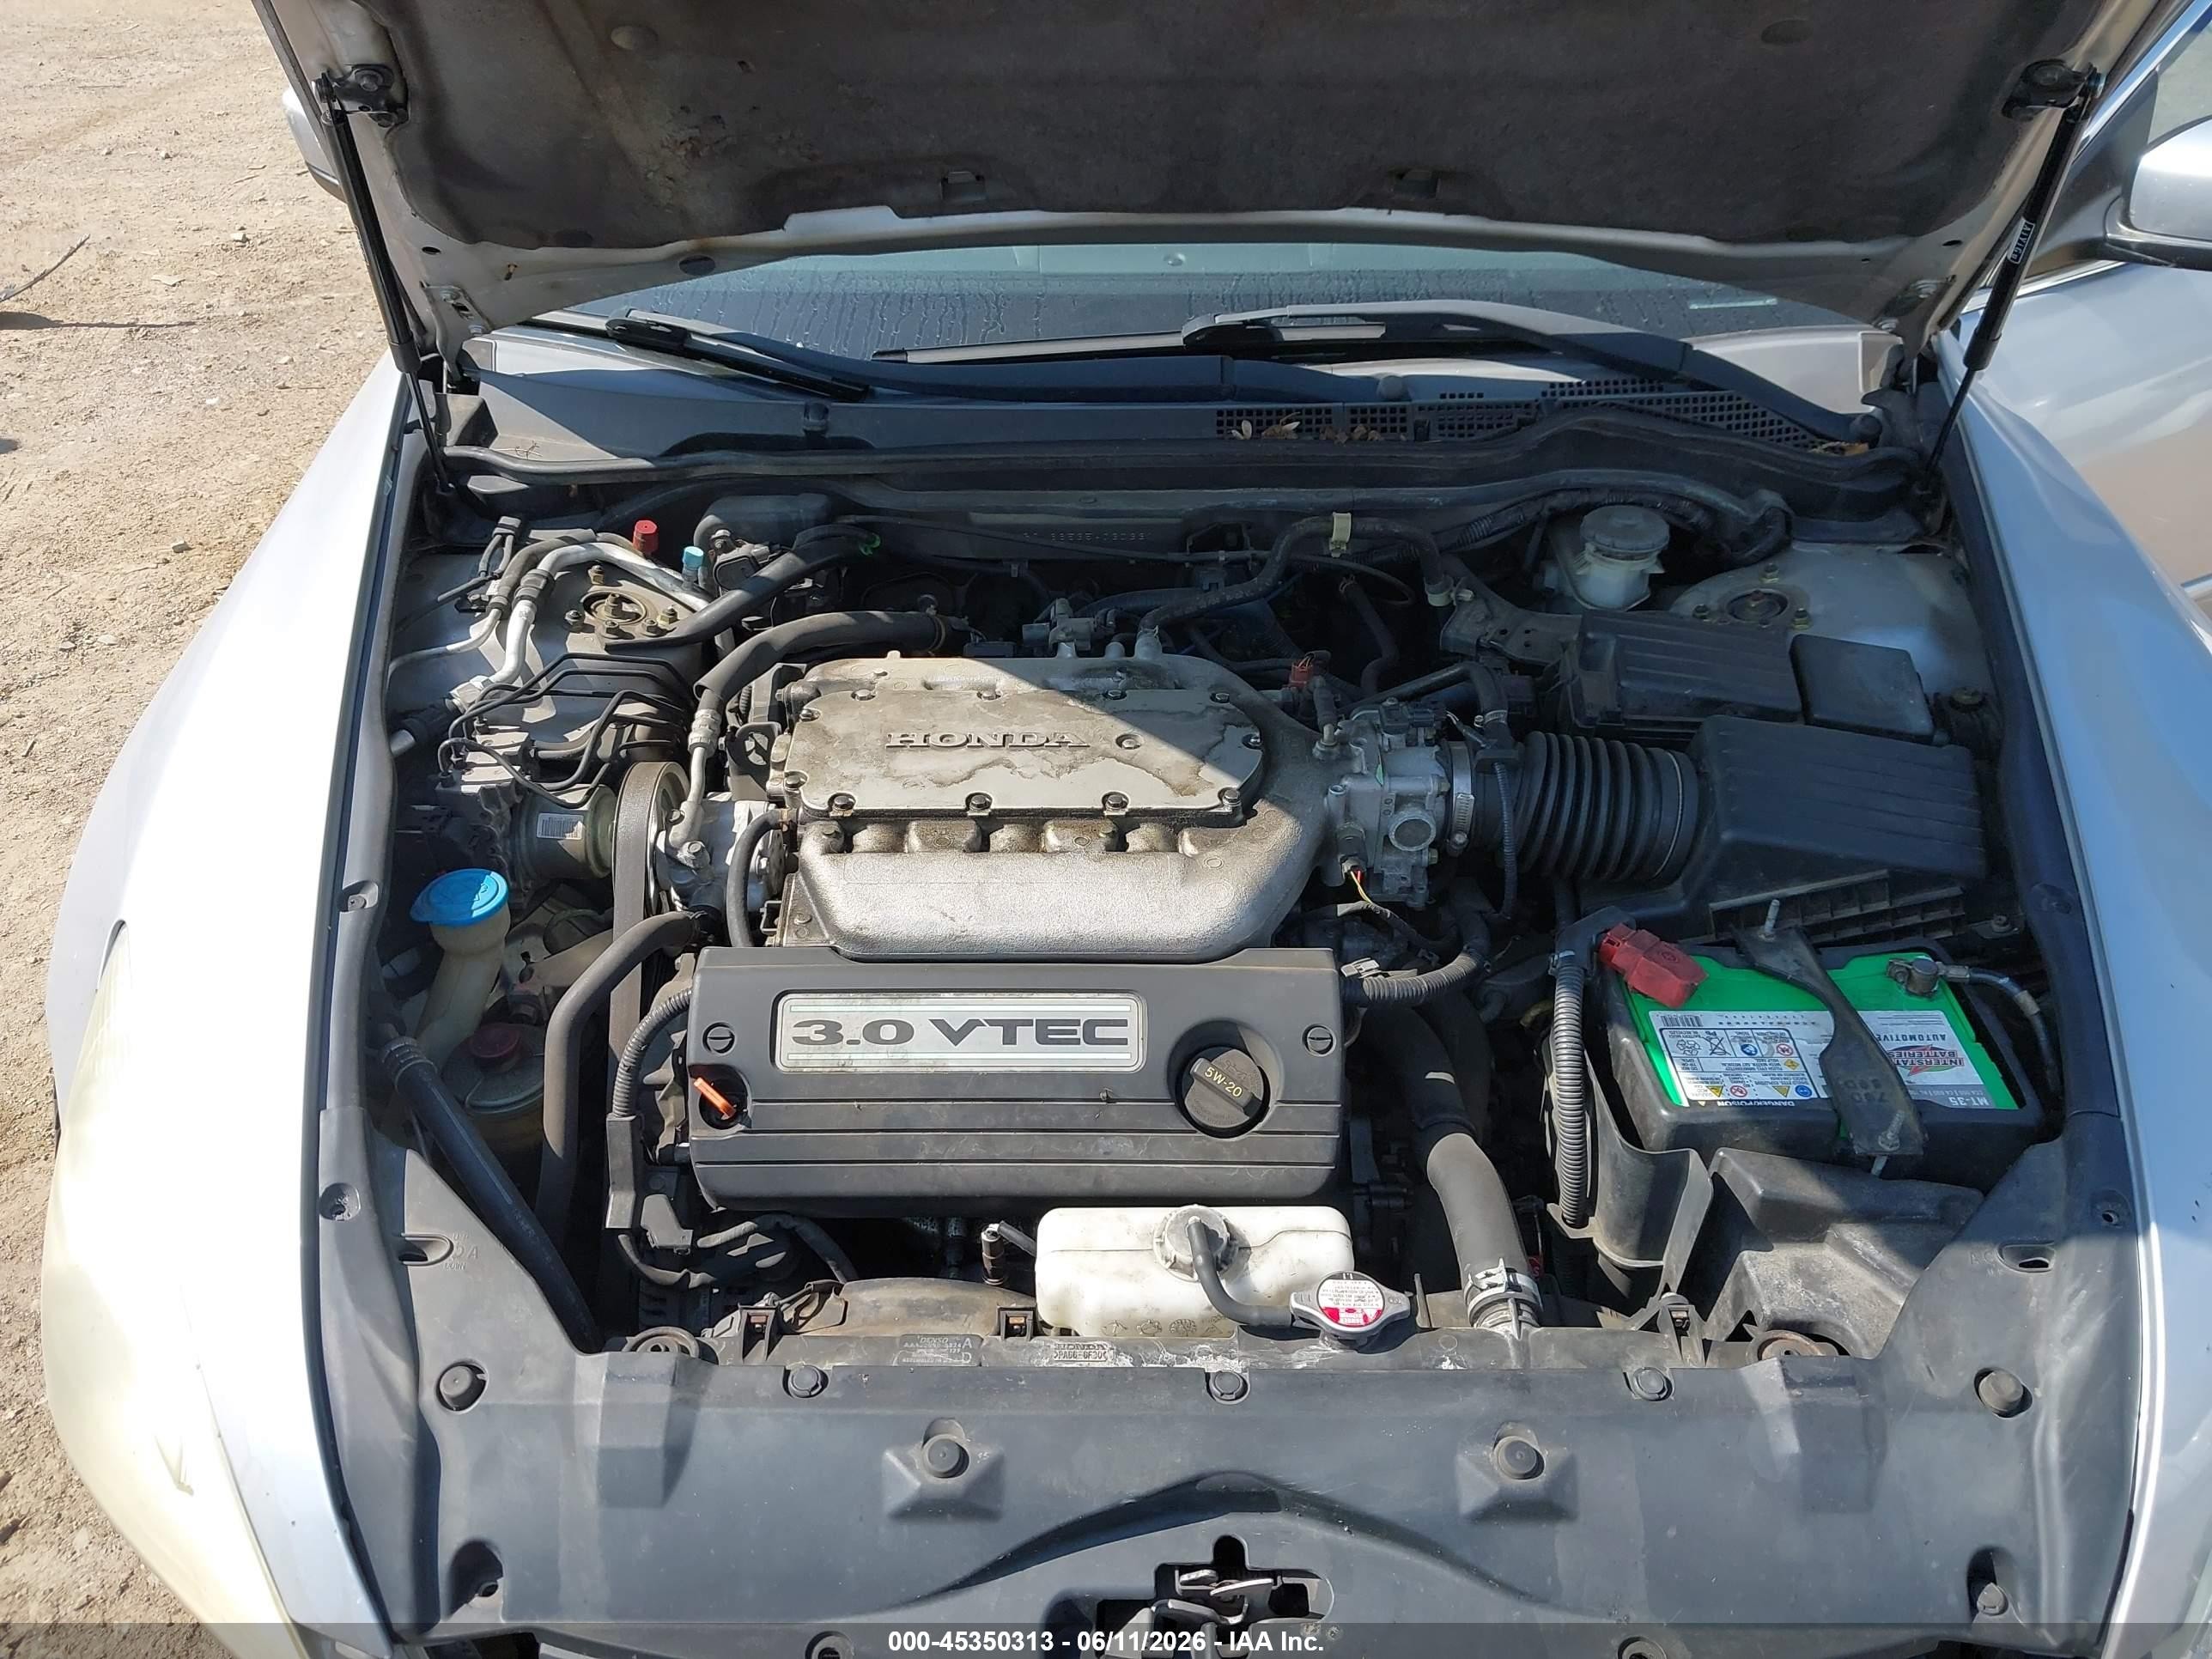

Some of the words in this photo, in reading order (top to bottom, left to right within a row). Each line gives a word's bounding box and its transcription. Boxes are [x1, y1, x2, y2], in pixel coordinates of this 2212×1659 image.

[885, 731, 1089, 748] HONDA
[792, 1018, 915, 1047] 3.0
[928, 1018, 1128, 1047] VTEC
[1875, 1033, 1947, 1042] AUTOMOTIVE
[1204, 1066, 1243, 1098] 5W-20
[1948, 1096, 1990, 1106] MT-35
